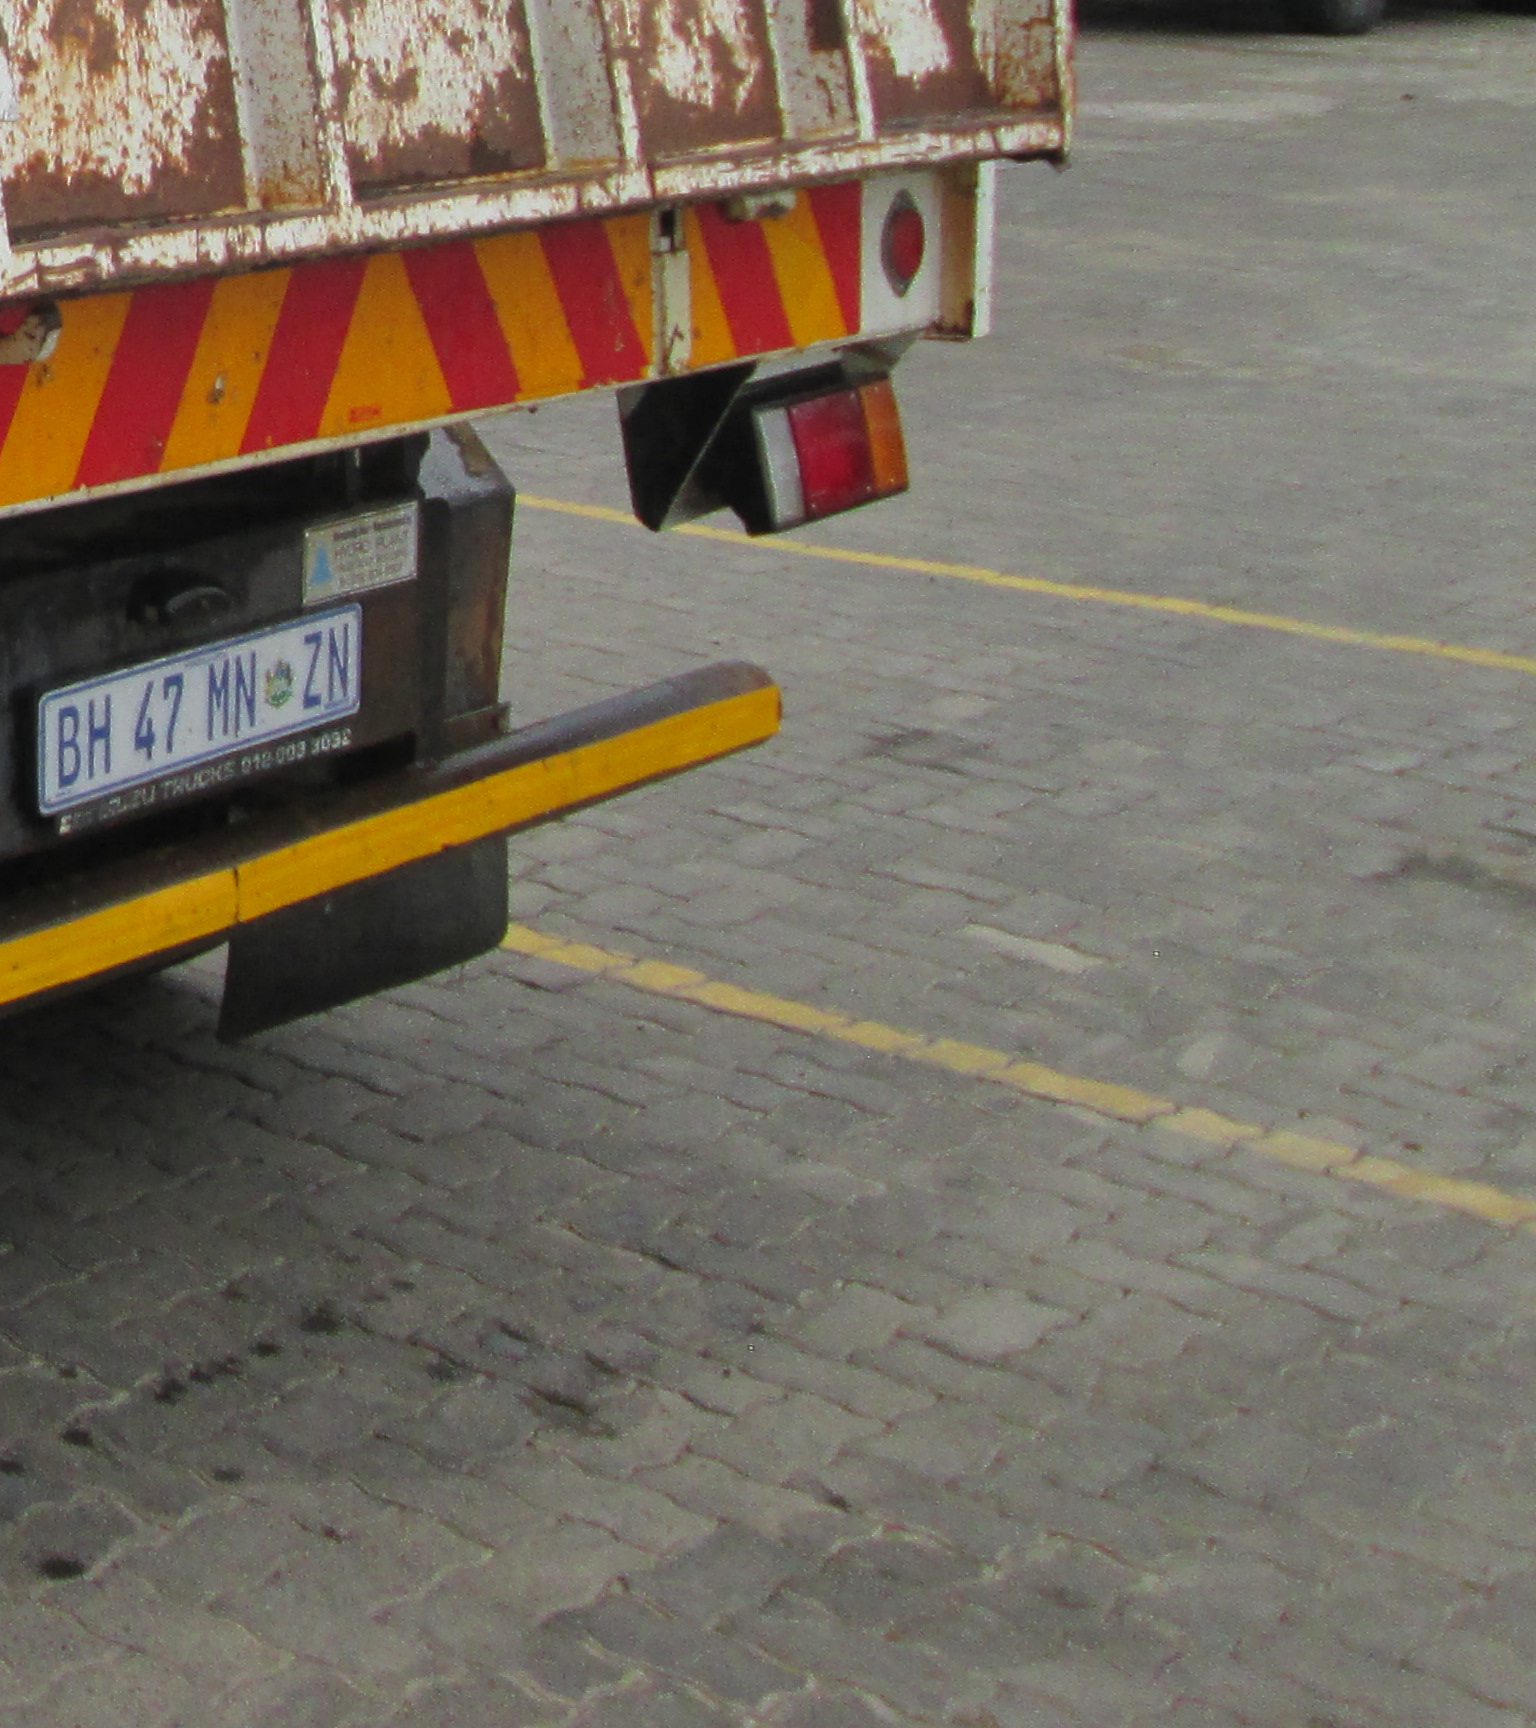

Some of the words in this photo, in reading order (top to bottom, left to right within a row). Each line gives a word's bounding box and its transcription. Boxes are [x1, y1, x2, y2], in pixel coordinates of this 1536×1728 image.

[58, 694, 111, 788] BH
[134, 675, 183, 760] 47
[207, 651, 256, 741] MN
[303, 624, 349, 709] ZN
